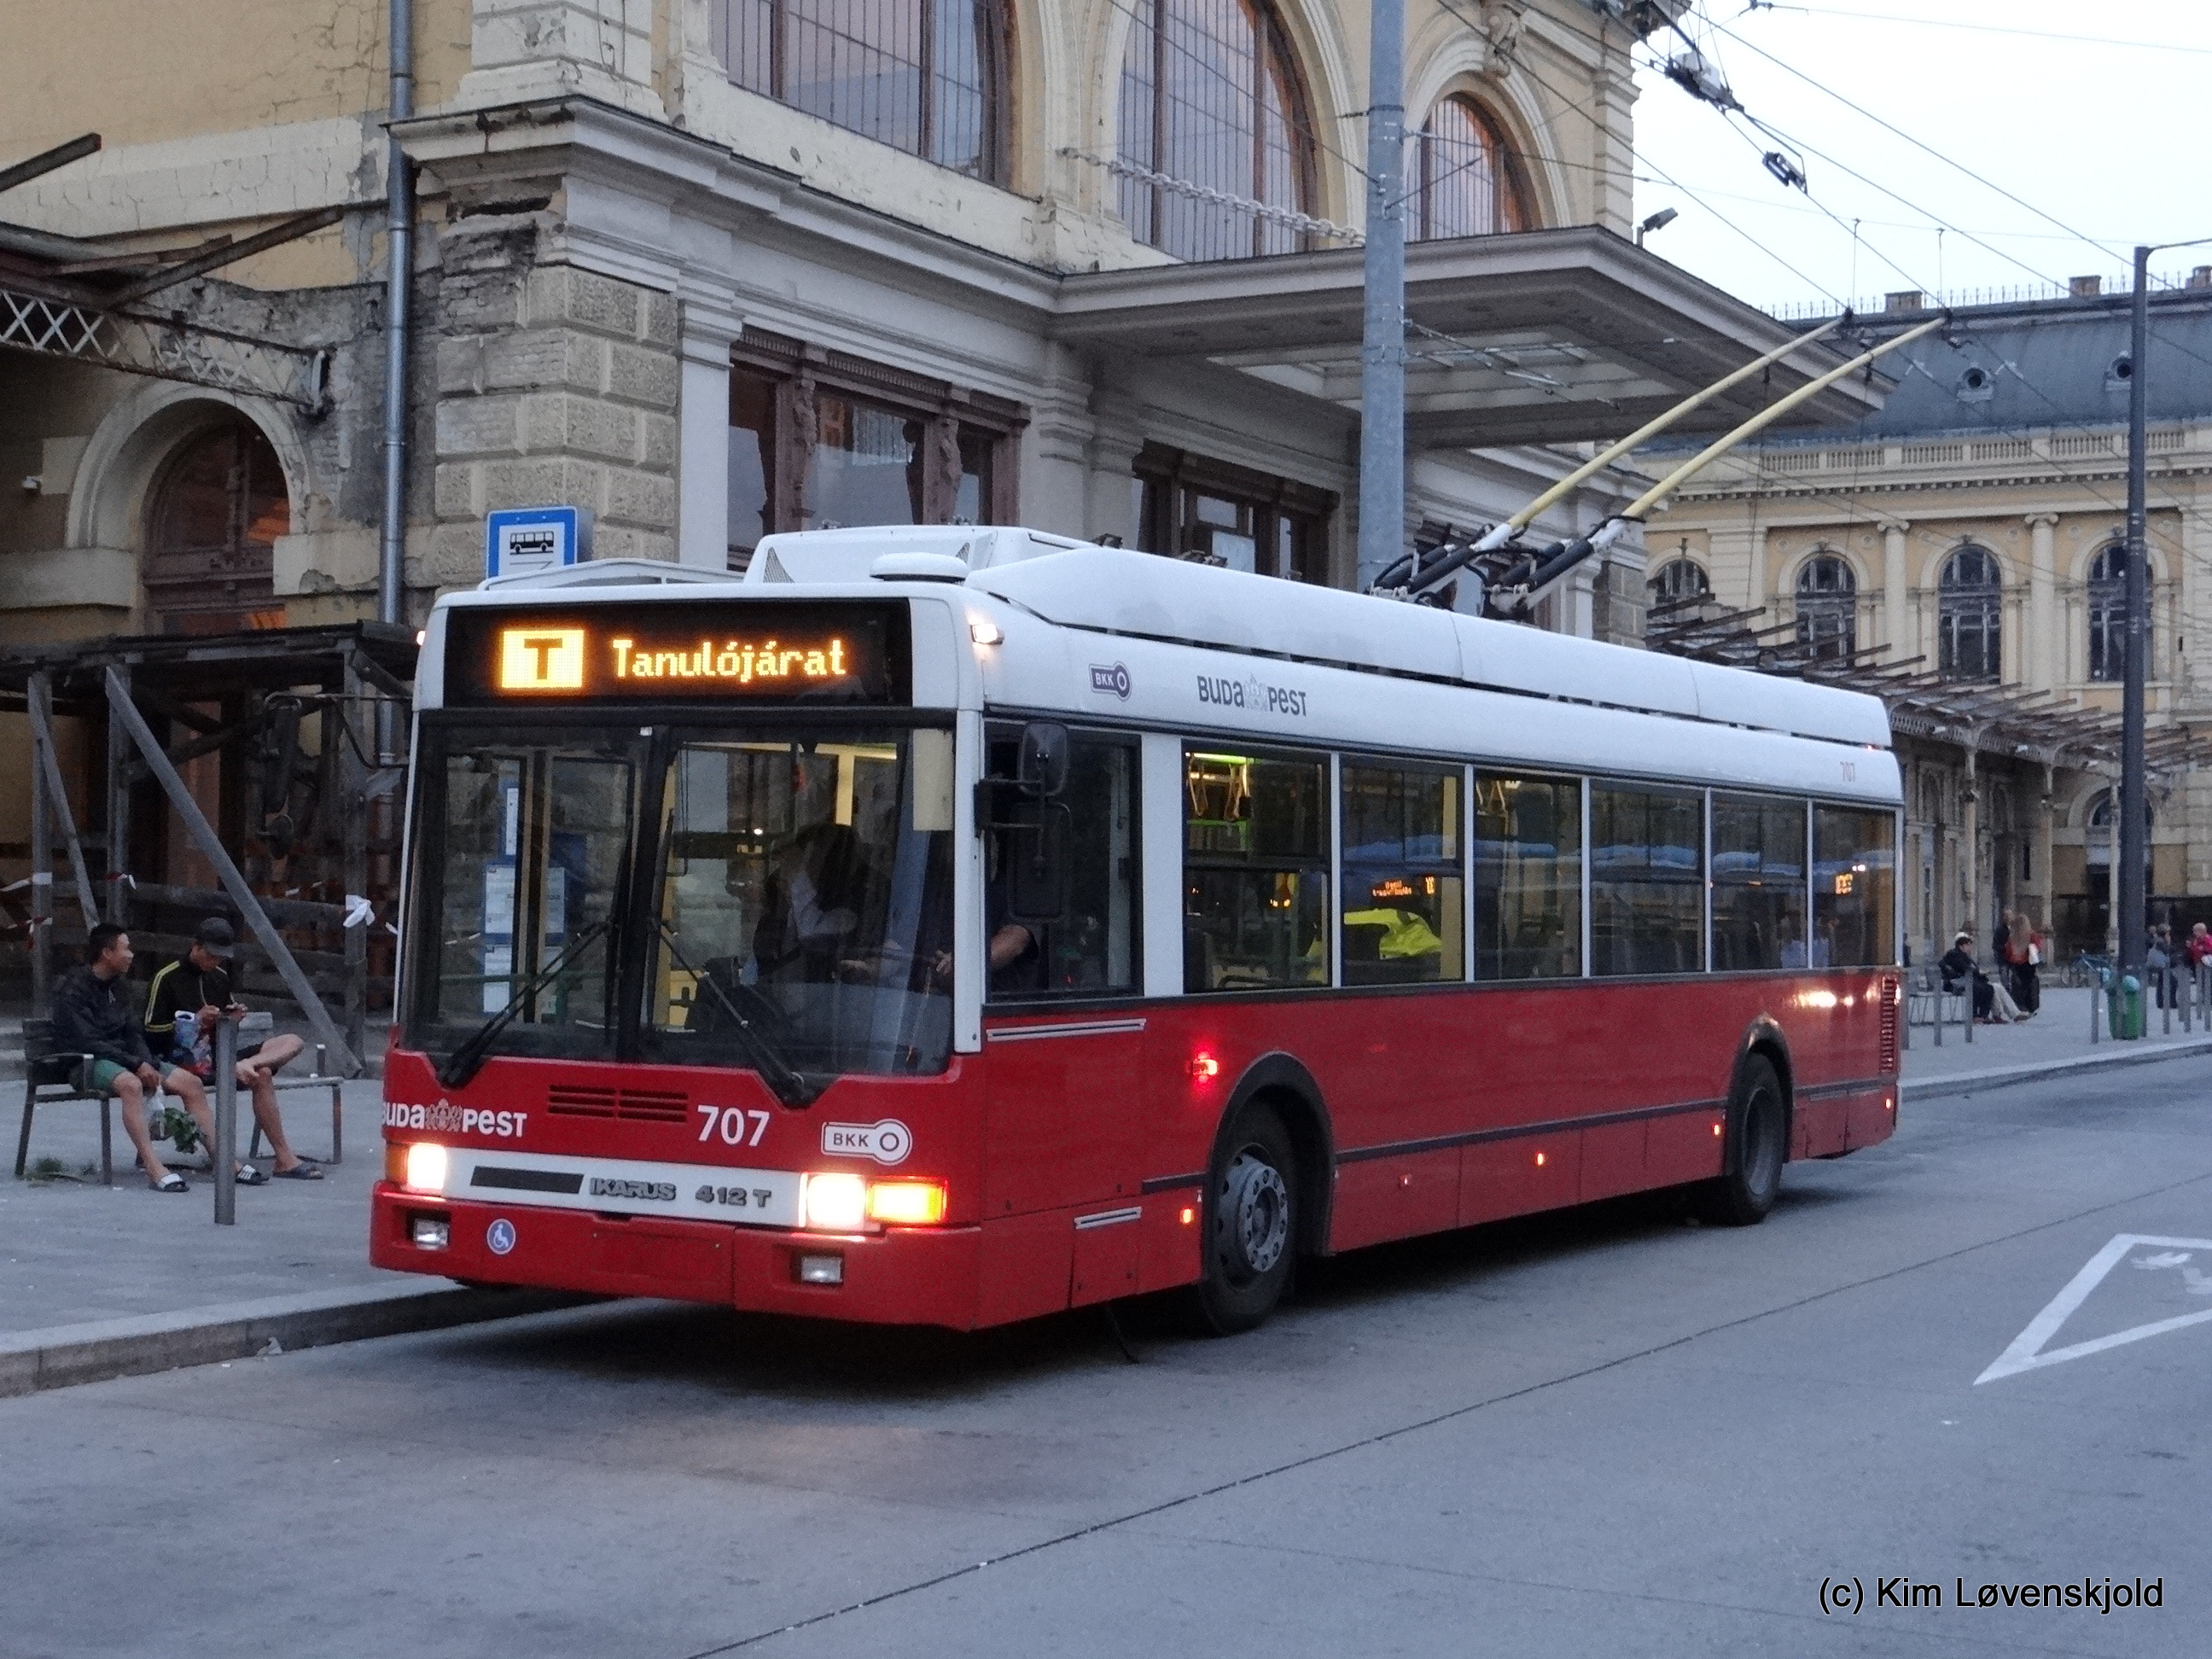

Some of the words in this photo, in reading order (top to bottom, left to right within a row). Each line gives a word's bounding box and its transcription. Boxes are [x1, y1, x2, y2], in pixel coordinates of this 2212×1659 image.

[523, 637, 563, 680] T
[612, 638, 847, 683] Tanulójárat
[1095, 672, 1115, 687] BKK
[697, 1105, 770, 1147] 707
[832, 1132, 870, 1149] BKK
[589, 1177, 677, 1202] IKARUS
[695, 1185, 747, 1207] 412
[752, 1188, 771, 1208] T
